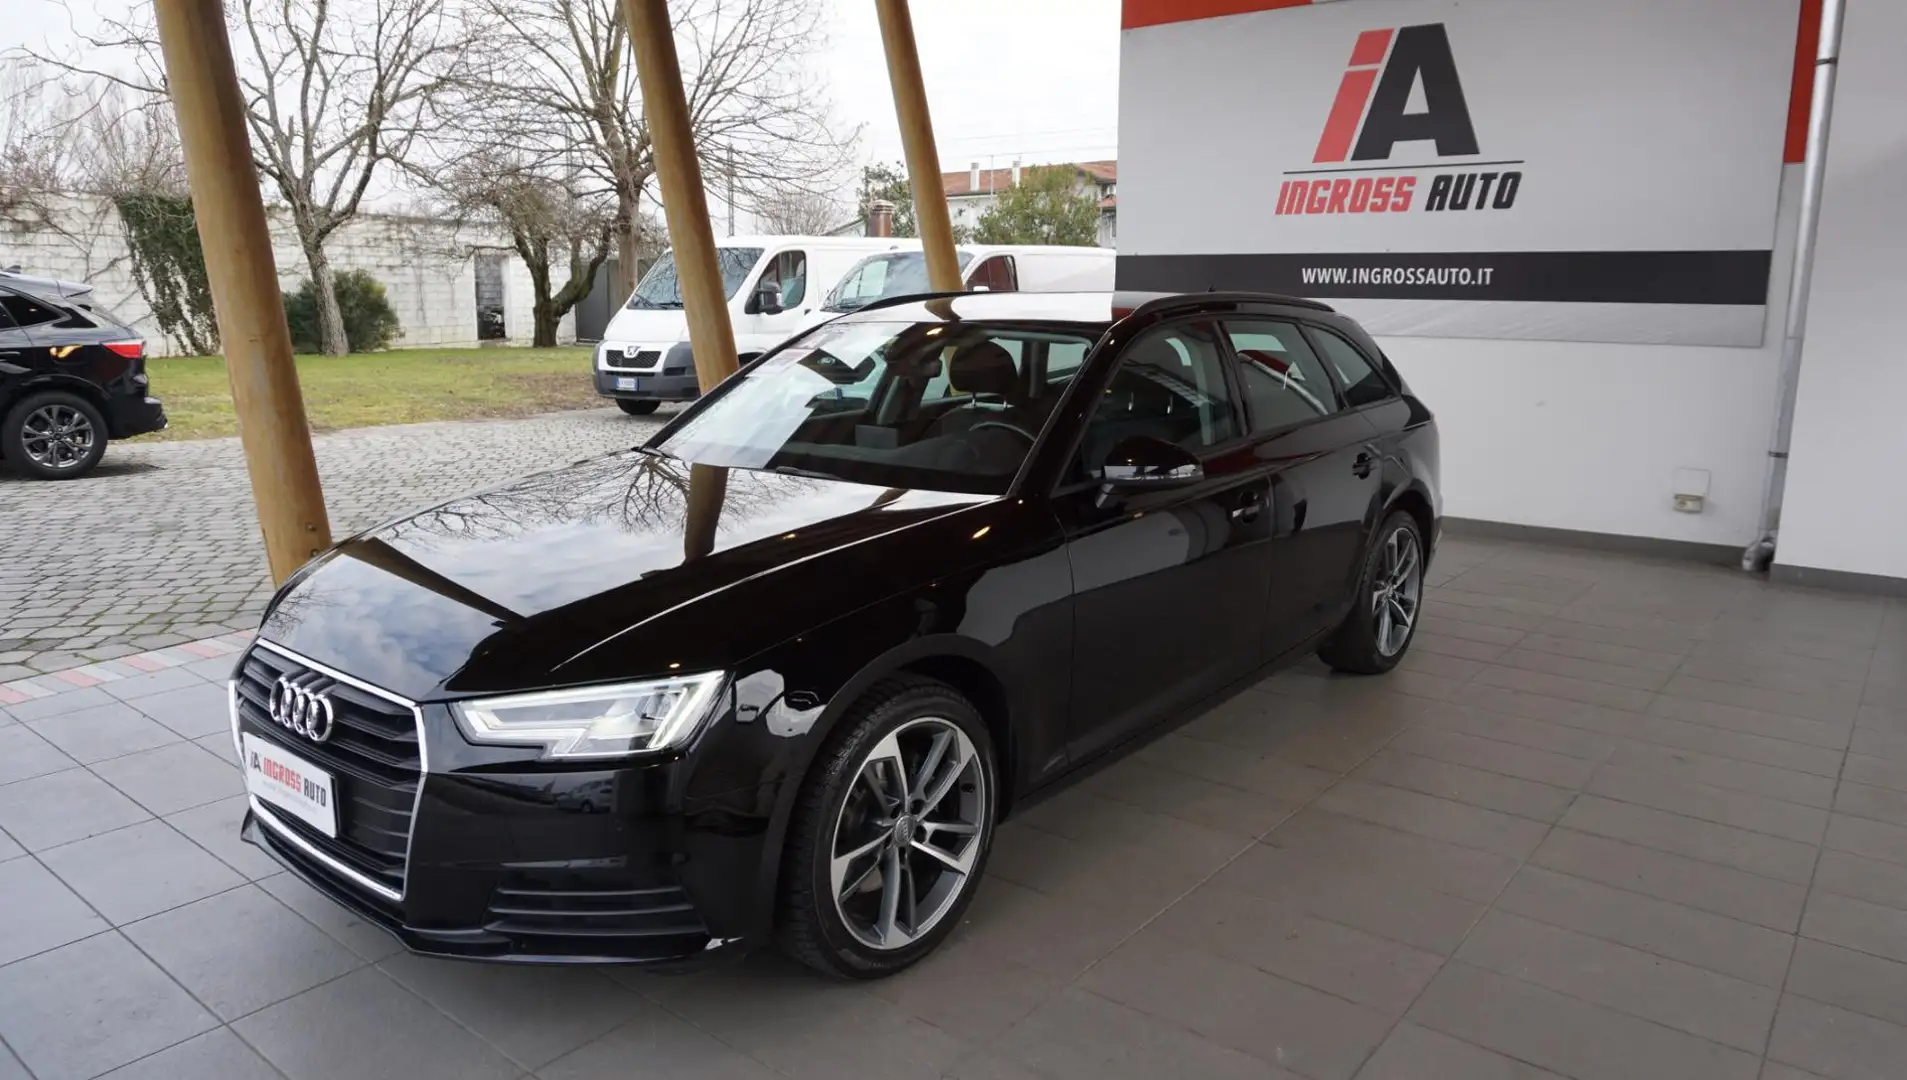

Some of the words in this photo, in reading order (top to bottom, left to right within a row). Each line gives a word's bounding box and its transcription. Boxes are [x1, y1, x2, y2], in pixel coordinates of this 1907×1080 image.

[1274, 176, 1417, 215] INGROSS
[1425, 171, 1522, 211] AUTO
[1302, 267, 1494, 285] WWW.INGROSSAUTO.IT
[263, 757, 302, 793] INGROSS
[304, 777, 326, 807] AUTO
